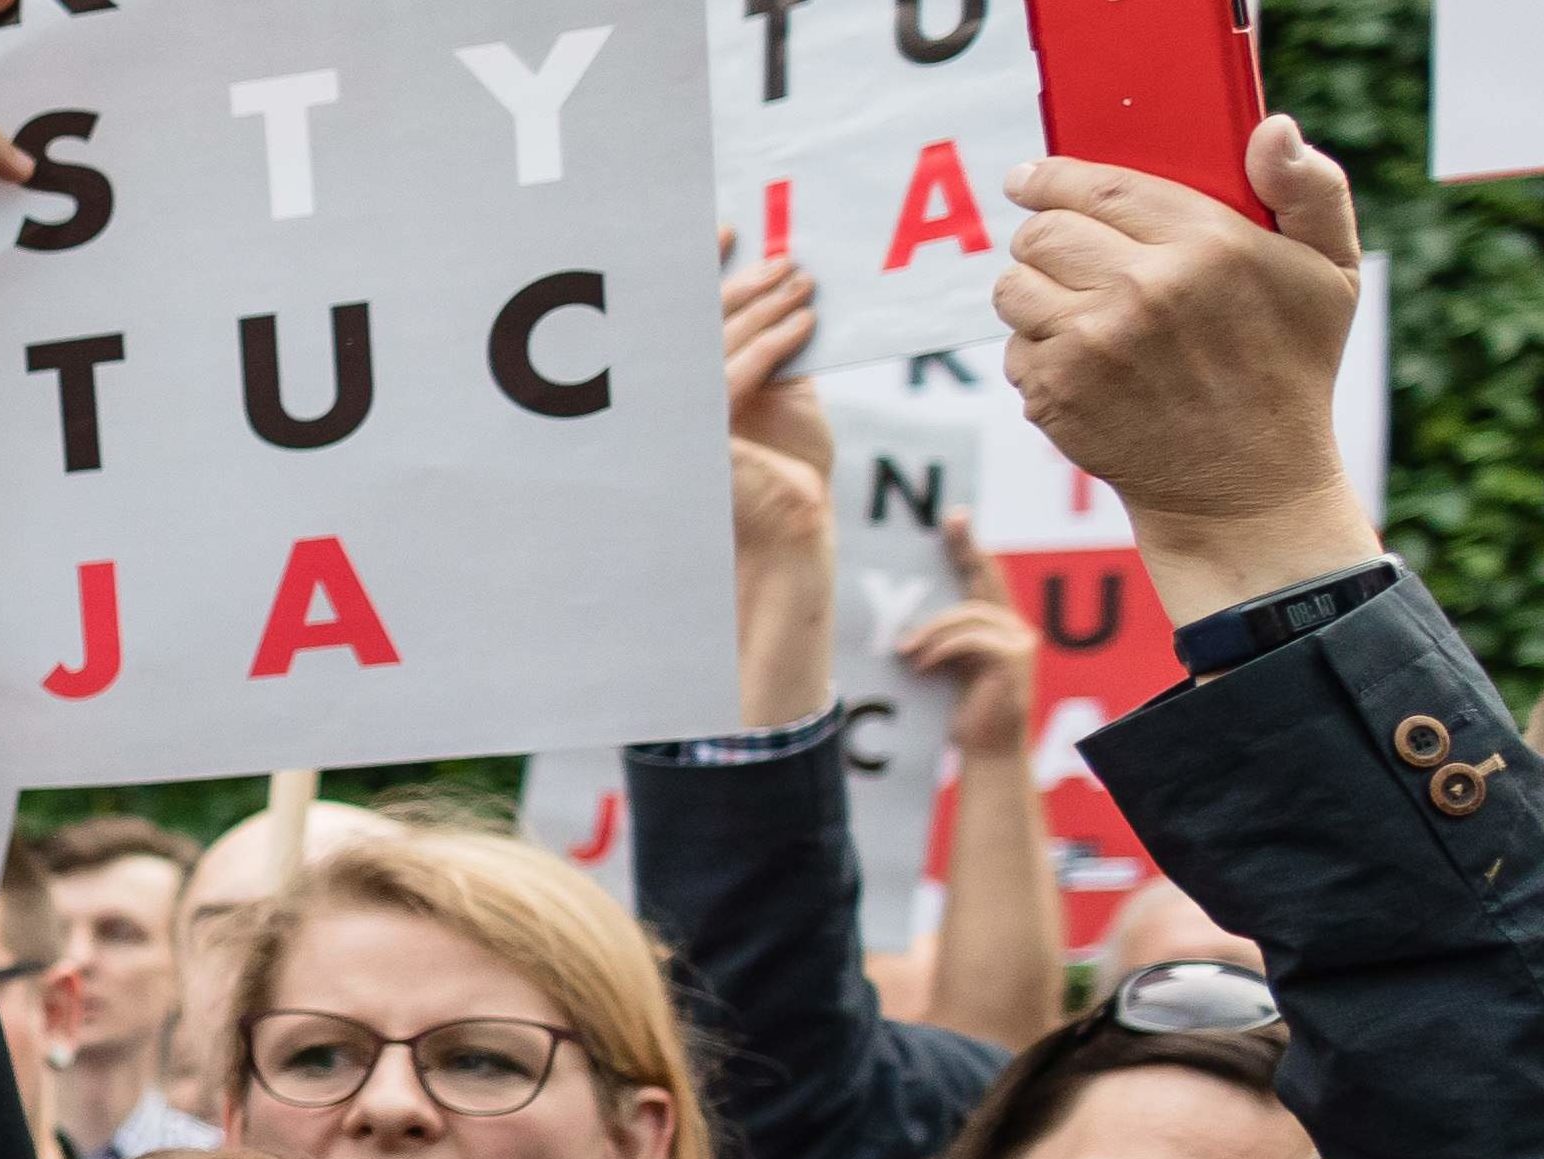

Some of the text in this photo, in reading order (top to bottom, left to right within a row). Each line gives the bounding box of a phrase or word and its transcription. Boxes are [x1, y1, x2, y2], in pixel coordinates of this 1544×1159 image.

[10, 25, 617, 253] STY
[25, 271, 613, 473] TUC
[42, 537, 403, 700] JA
